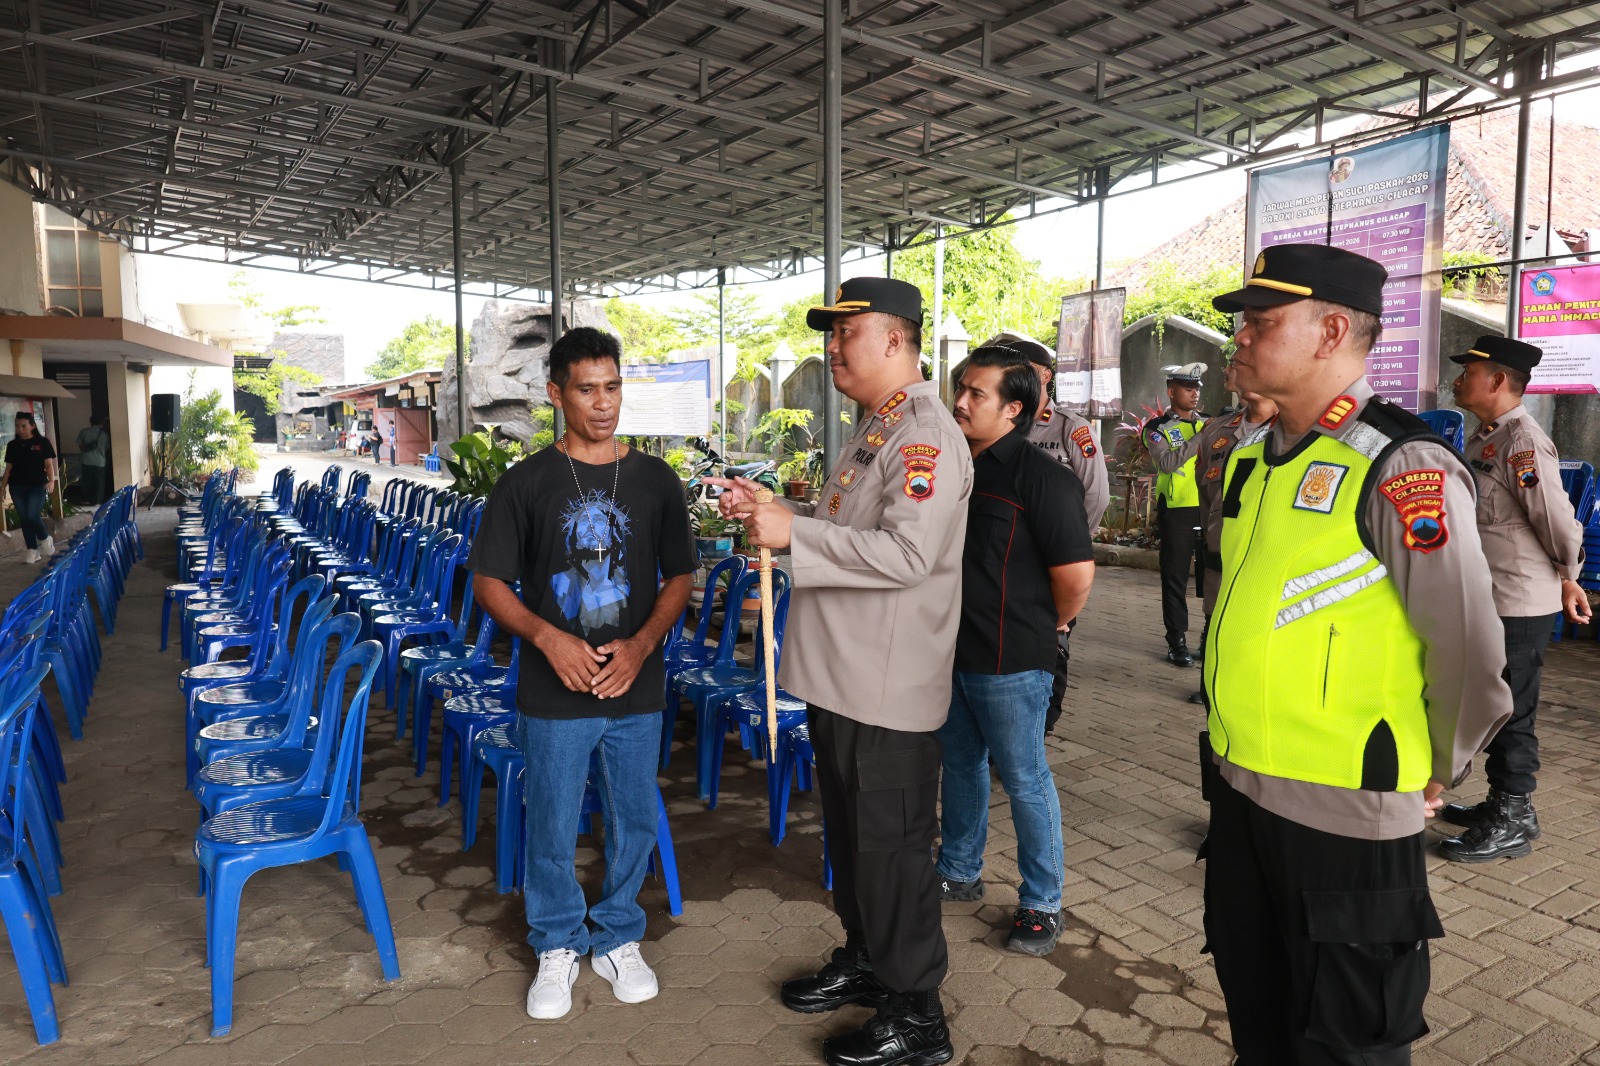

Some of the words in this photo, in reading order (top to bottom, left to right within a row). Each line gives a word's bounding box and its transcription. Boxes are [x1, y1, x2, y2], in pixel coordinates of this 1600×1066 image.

[1262, 200, 1294, 213] JADWAL
[1295, 196, 1315, 207] MISA
[1317, 190, 1344, 202] PEKAN
[1346, 186, 1366, 197] SUCI
[1368, 178, 1404, 192] PASKAH
[1406, 171, 1429, 184] 2026
[1262, 211, 1294, 224] PAROKI
[1297, 206, 1325, 219] SANTO
[1329, 194, 1384, 212] STEPHANUS
[1387, 184, 1429, 201] CILACAP
[1274, 232, 1301, 241] GEREJA
[1303, 227, 1327, 236] SANTO
[1330, 218, 1375, 232] STEPHANUS
[1376, 211, 1410, 222] CILACAP
[1345, 237, 1360, 245] 2026
[1381, 248, 1396, 256] 18:00
[1523, 302, 1562, 313] TAMAN
[1523, 314, 1558, 324] MARIA
[1560, 312, 1600, 322] IMMAC
[1370, 345, 1403, 353] AZENOD
[904, 445, 937, 454] POLRESTA
[852, 448, 876, 466] POLRI
[1385, 472, 1441, 493] POLRESTA
[1395, 484, 1439, 500] CILACAP
[1402, 503, 1416, 512] JAWA
